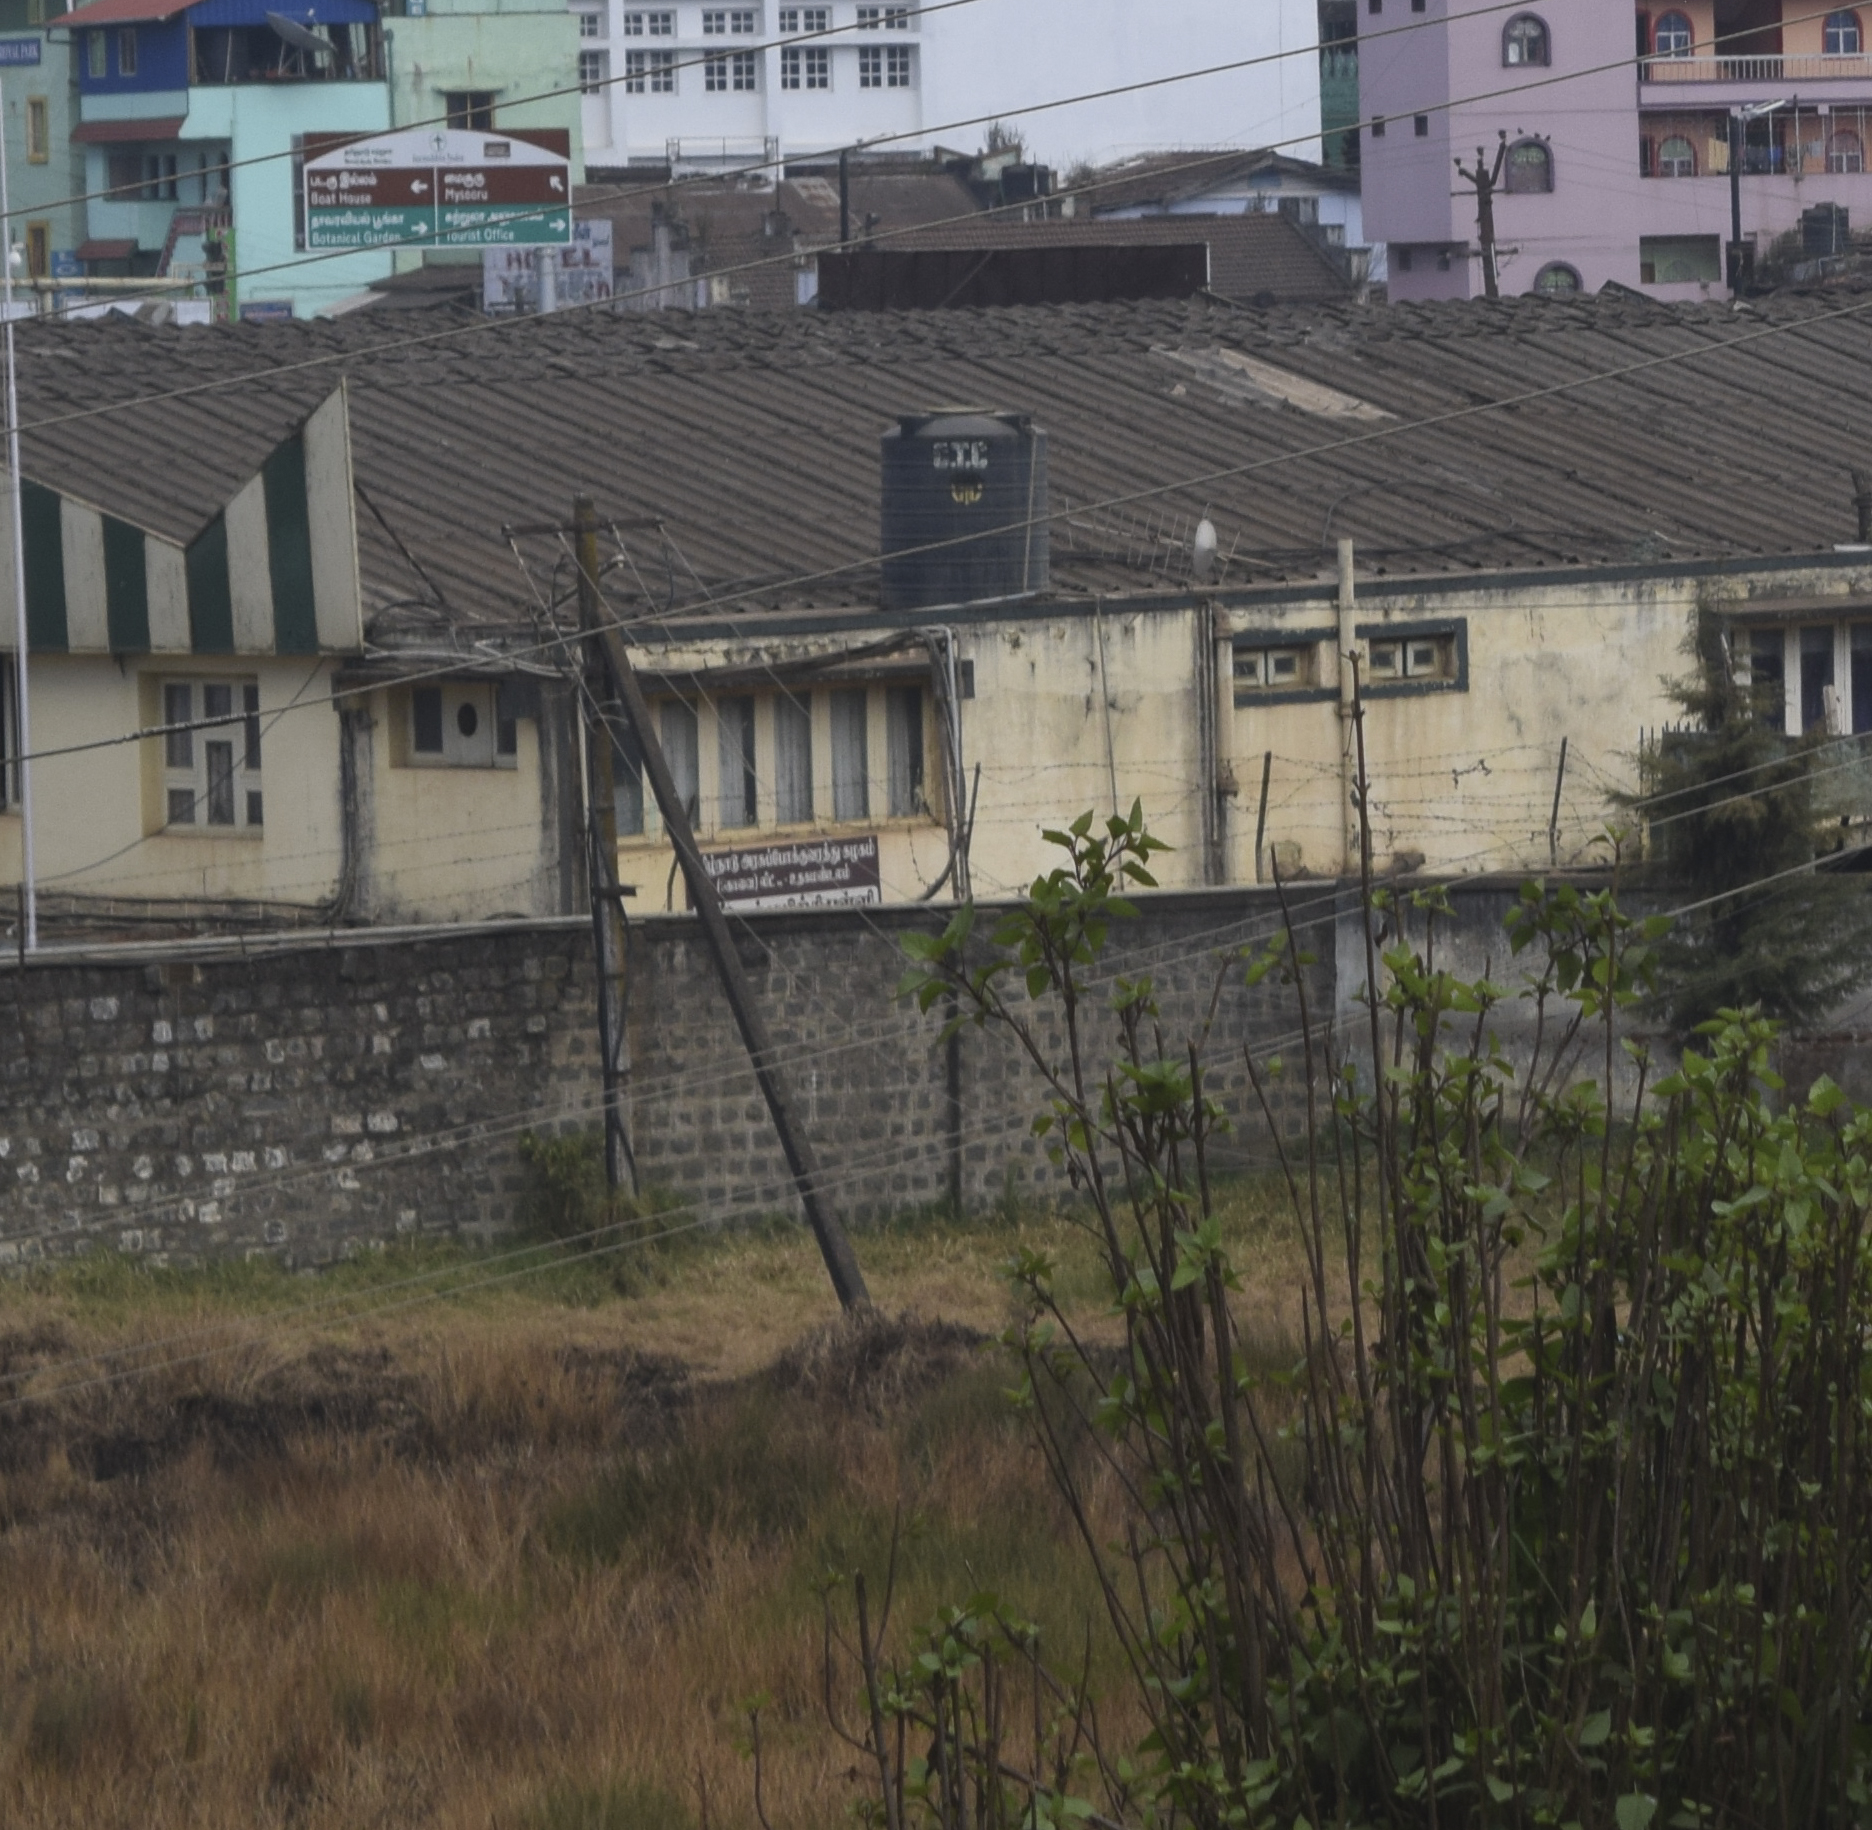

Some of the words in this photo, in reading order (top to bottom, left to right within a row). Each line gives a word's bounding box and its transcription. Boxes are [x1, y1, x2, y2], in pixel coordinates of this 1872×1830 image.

[311, 192, 336, 206] Boat
[339, 190, 372, 205] House
[312, 231, 361, 245] Botanical
[364, 230, 401, 243] Garden
[485, 226, 515, 241] Office
